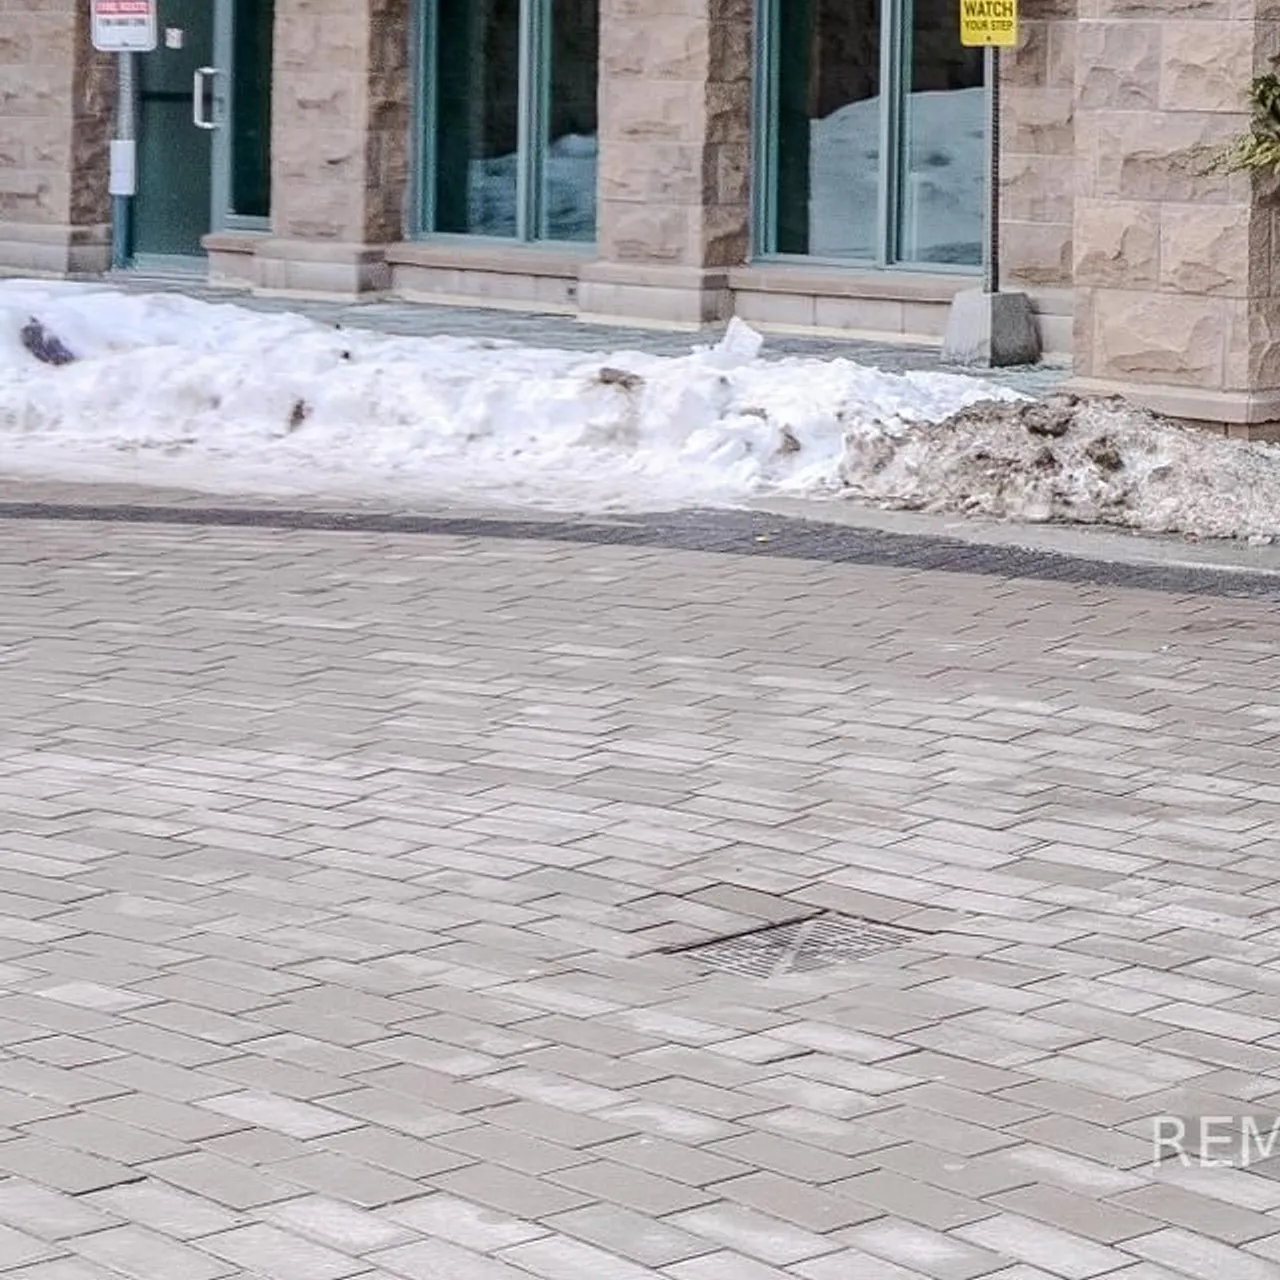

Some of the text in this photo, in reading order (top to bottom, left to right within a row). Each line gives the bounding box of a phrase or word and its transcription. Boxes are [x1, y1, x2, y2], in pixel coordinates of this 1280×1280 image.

[963, 1, 1013, 17] WATCH
[963, 20, 1013, 31] YOUR STEP
